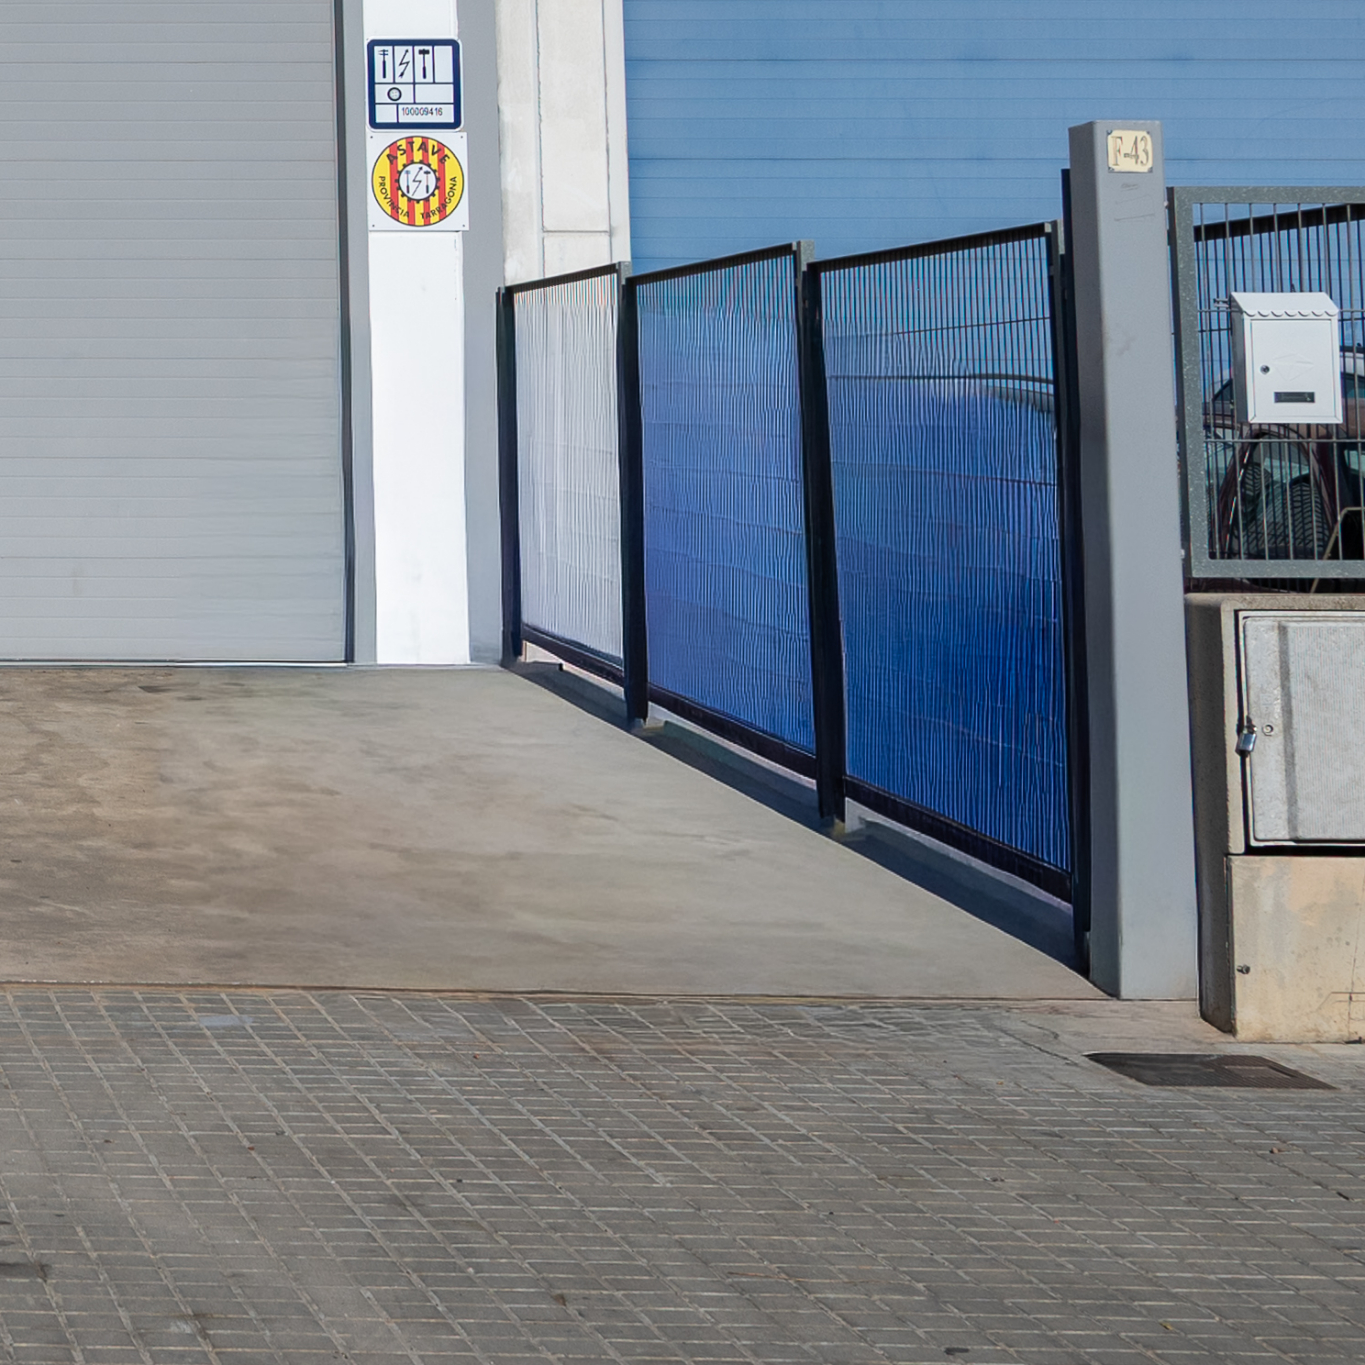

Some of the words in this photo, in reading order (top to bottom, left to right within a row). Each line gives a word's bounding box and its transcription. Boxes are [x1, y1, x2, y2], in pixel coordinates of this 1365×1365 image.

[386, 140, 450, 165] ASTAVE
[1111, 135, 1149, 166] F-43
[378, 175, 410, 219] PROVINCIA
[420, 175, 458, 220] TARRAGONA
